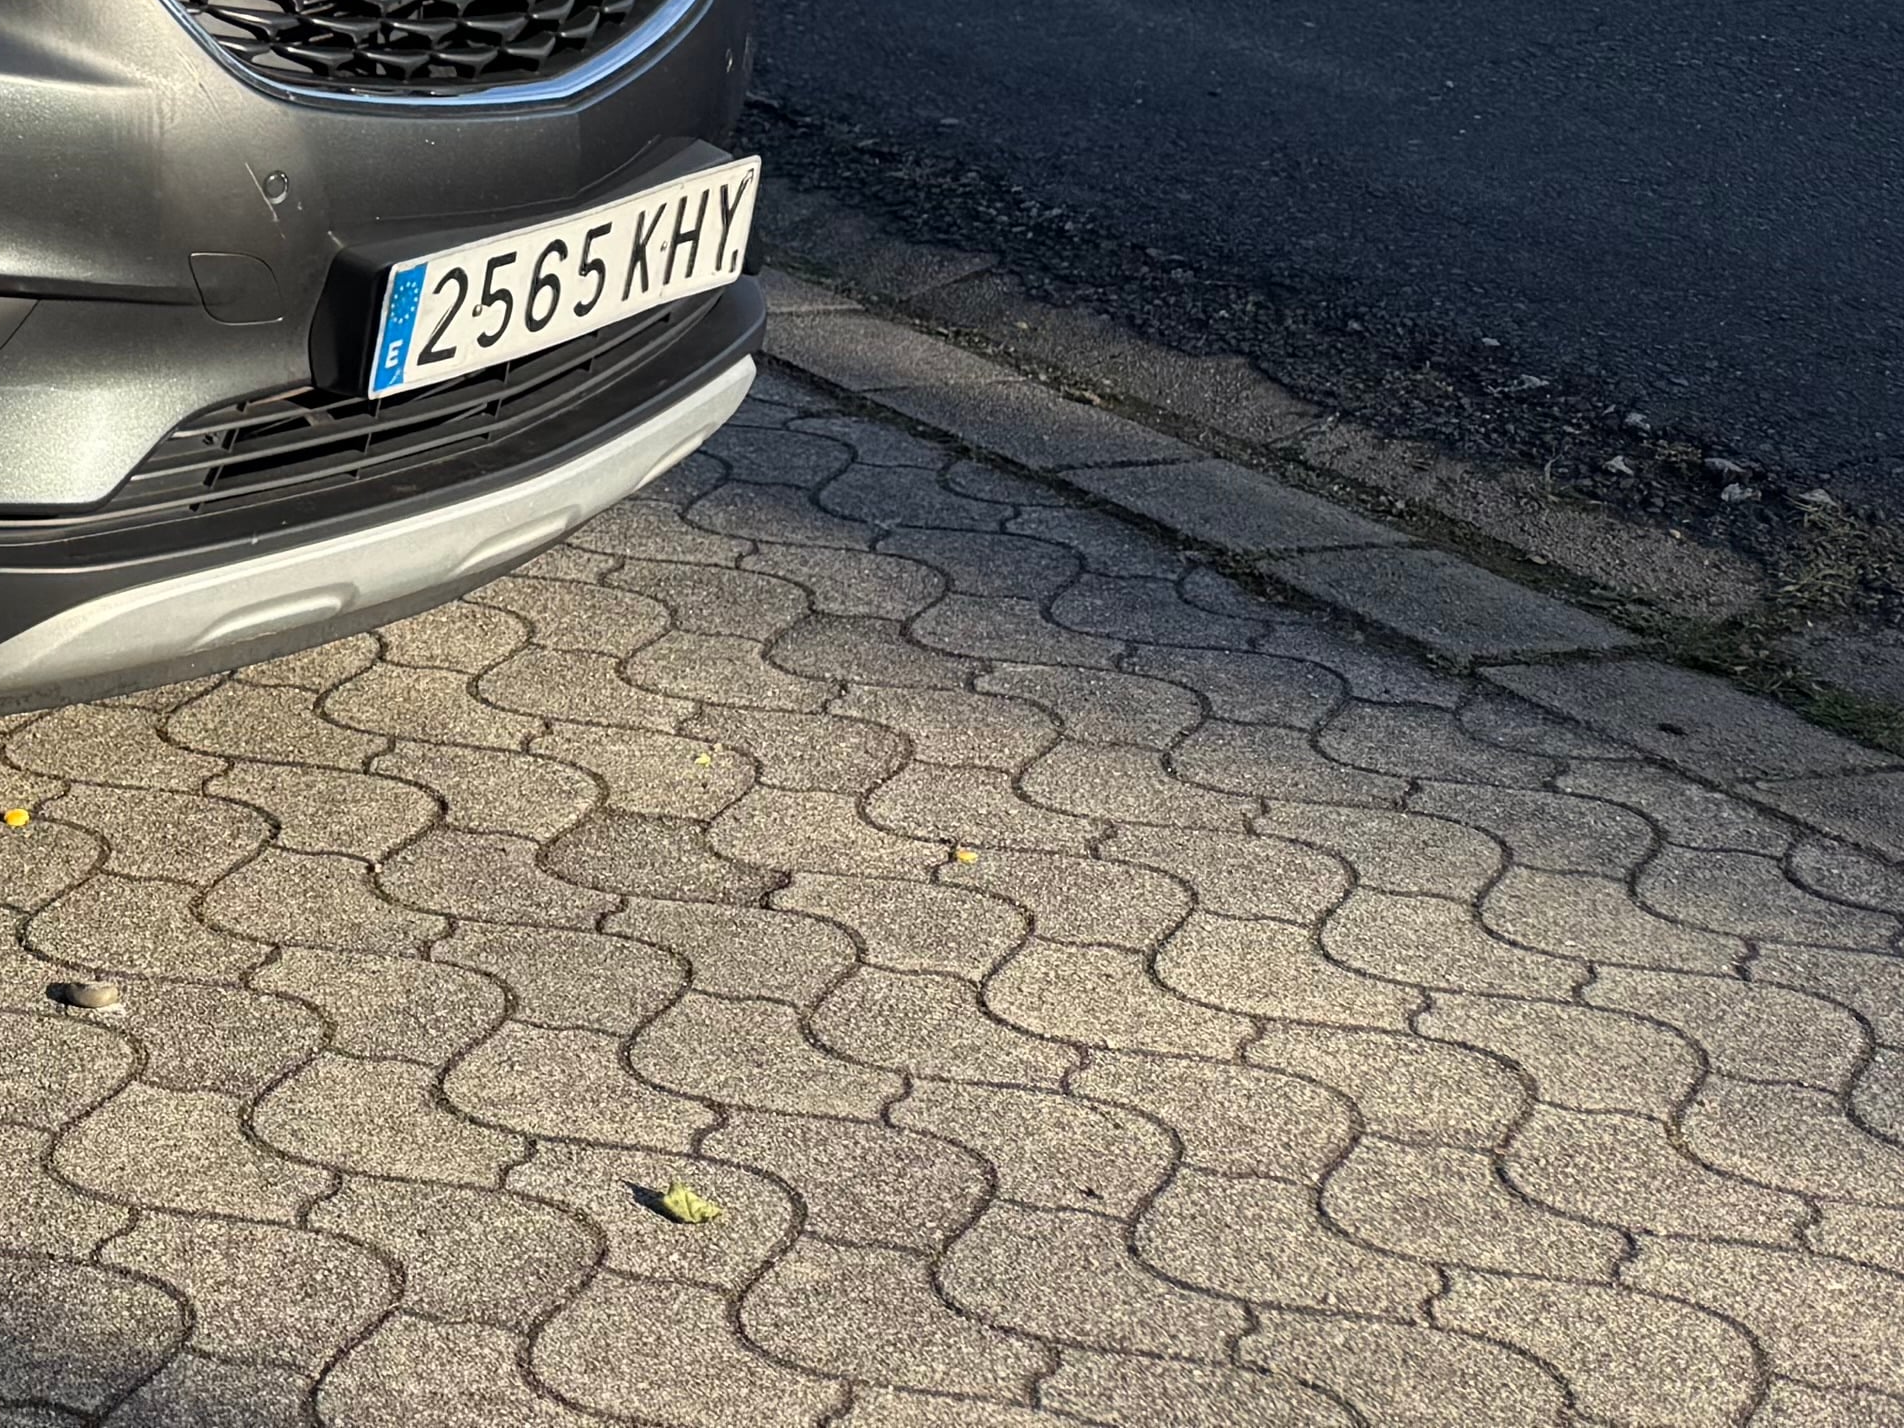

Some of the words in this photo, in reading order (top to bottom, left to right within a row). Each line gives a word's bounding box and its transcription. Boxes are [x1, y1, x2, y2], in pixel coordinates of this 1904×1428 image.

[417, 221, 613, 366] 2565
[621, 167, 755, 302] KHY
[384, 339, 404, 368] E
